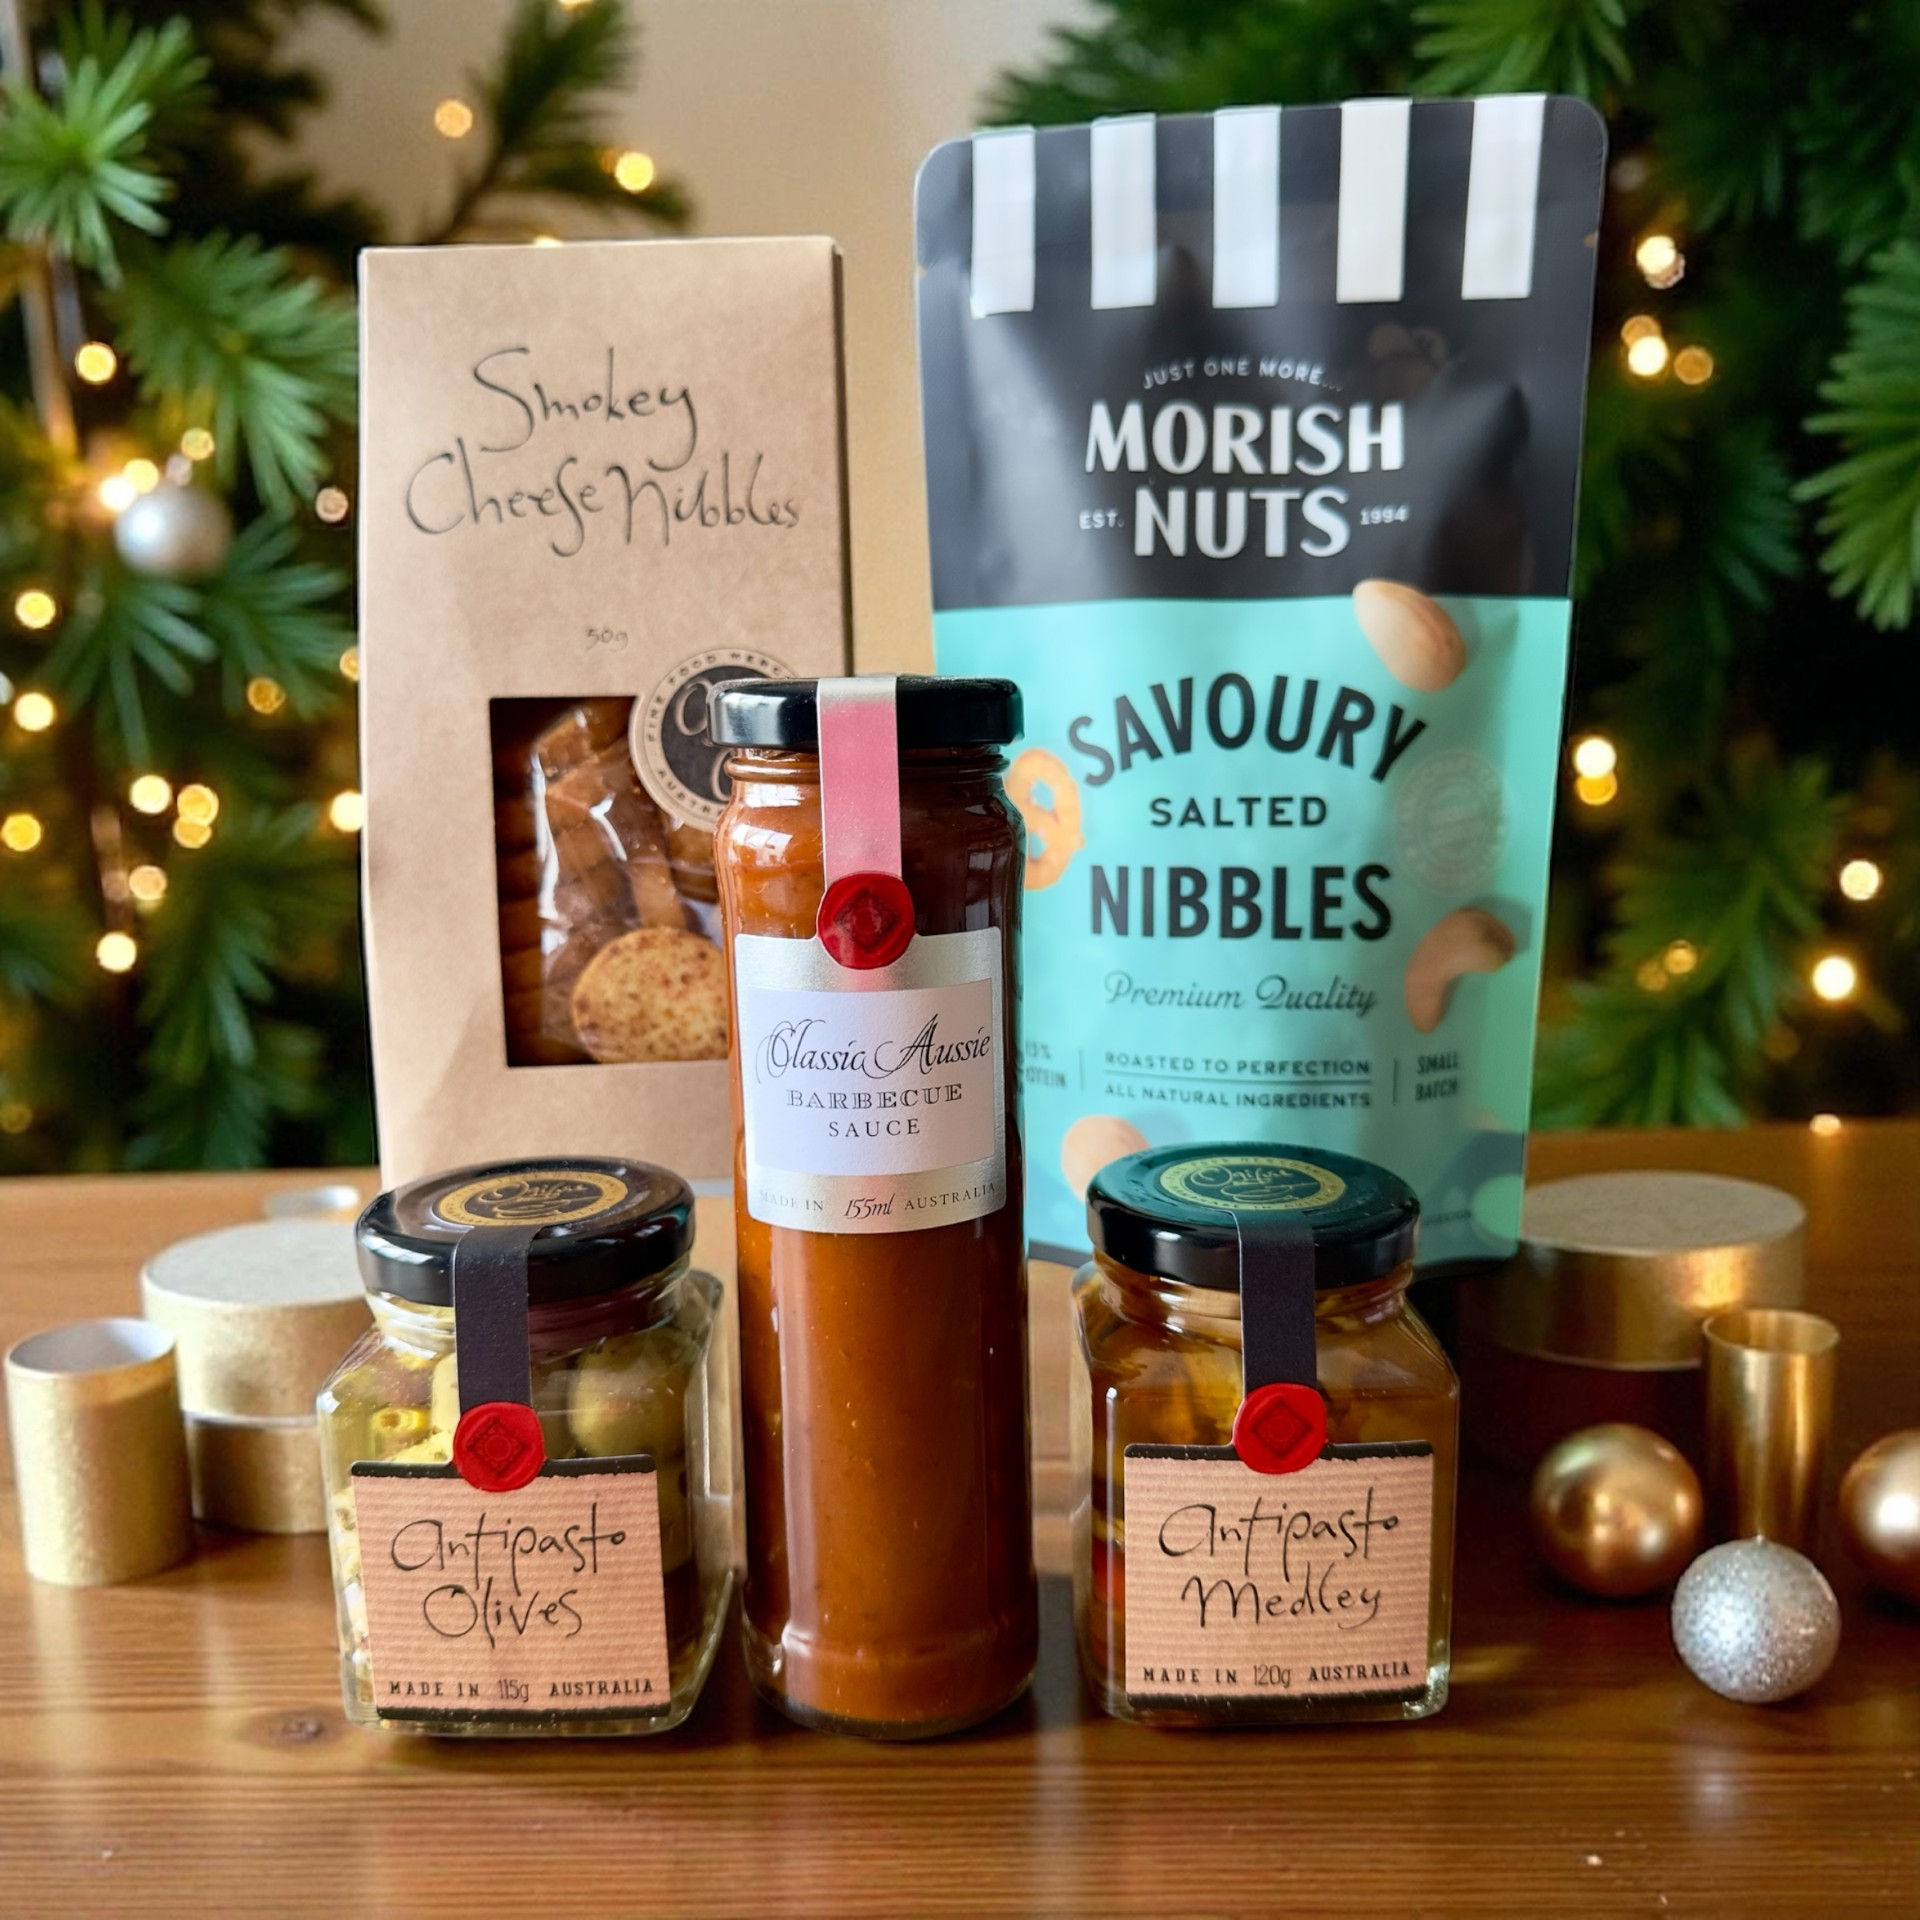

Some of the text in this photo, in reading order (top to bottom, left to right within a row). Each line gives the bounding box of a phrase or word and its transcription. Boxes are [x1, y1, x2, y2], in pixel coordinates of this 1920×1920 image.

[1144, 358, 1196, 389] JUST
[1204, 355, 1250, 377] ONE
[473, 346, 697, 471] Smokey
[1085, 399, 1405, 476] MORISH
[406, 437, 602, 556] Cheese
[1360, 506, 1410, 525] 1994
[1134, 485, 1349, 559] NUTS
[1068, 672, 1427, 787] SAVOURY
[1149, 796, 1327, 827] SALTED
[1090, 864, 1392, 941] NIBBLES
[1104, 970, 1377, 1018] Premium Quality
[756, 1013, 991, 1084] Classic Aussie
[1104, 1052, 1369, 1075] ROASTED TO PERFECTION
[1417, 1052, 1459, 1075] SMALL
[787, 1083, 962, 1109] BARBECUE
[1105, 1083, 1370, 1109] ALL NATURAL INGREDIENTS
[1415, 1078, 1458, 1101] BATCH
[829, 1118, 920, 1138] SAUCE
[805, 1199, 823, 1211] IN
[844, 1193, 895, 1219] 155ml
[904, 1182, 996, 1211] AUSTRALIA
[391, 1502, 626, 1596] Antipasto
[1158, 1487, 1398, 1582] Antipasto
[424, 1576, 582, 1649] Olives
[1181, 1562, 1381, 1630] Medley
[390, 1679, 653, 1702] MADE IN 115g AUSTRALIA
[1143, 1661, 1410, 1688] MADE IN 120g AUSTRALIA
